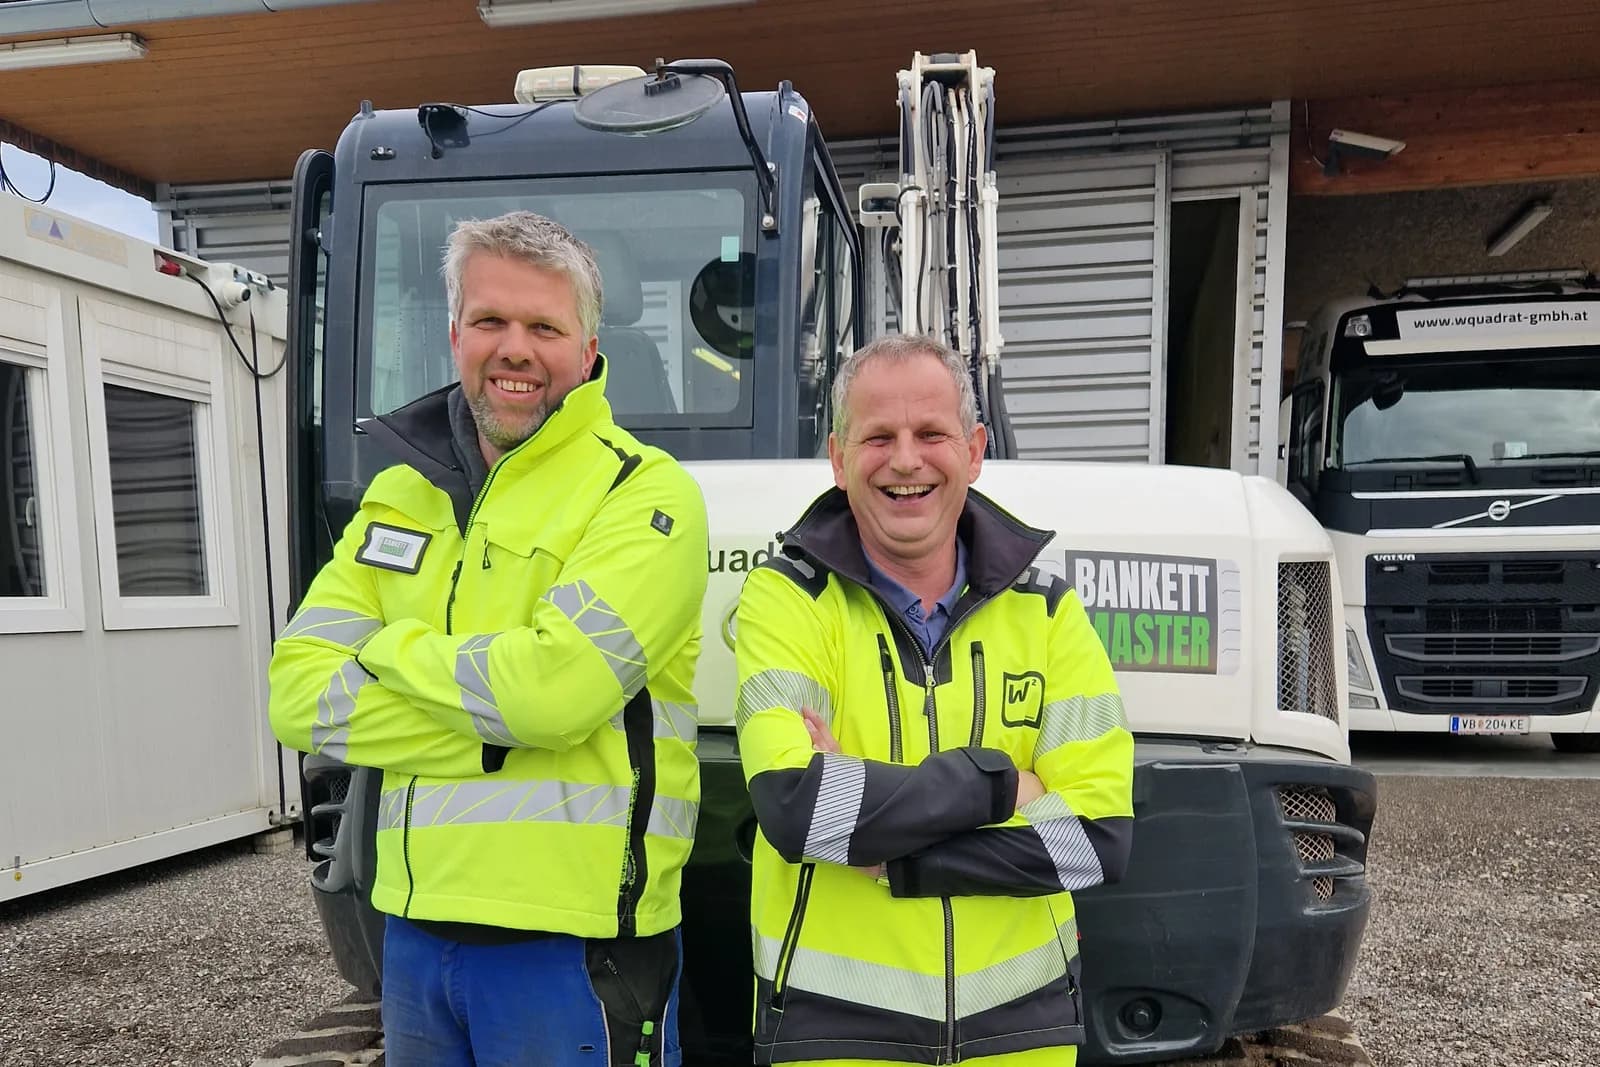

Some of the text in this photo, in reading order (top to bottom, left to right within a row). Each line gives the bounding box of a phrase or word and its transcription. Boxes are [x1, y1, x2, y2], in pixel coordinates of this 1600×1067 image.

[1413, 311, 1589, 329] www.wquadrat-gmbh.at
[1075, 558, 1209, 613] BANKETT
[1462, 719, 1476, 729] VB
